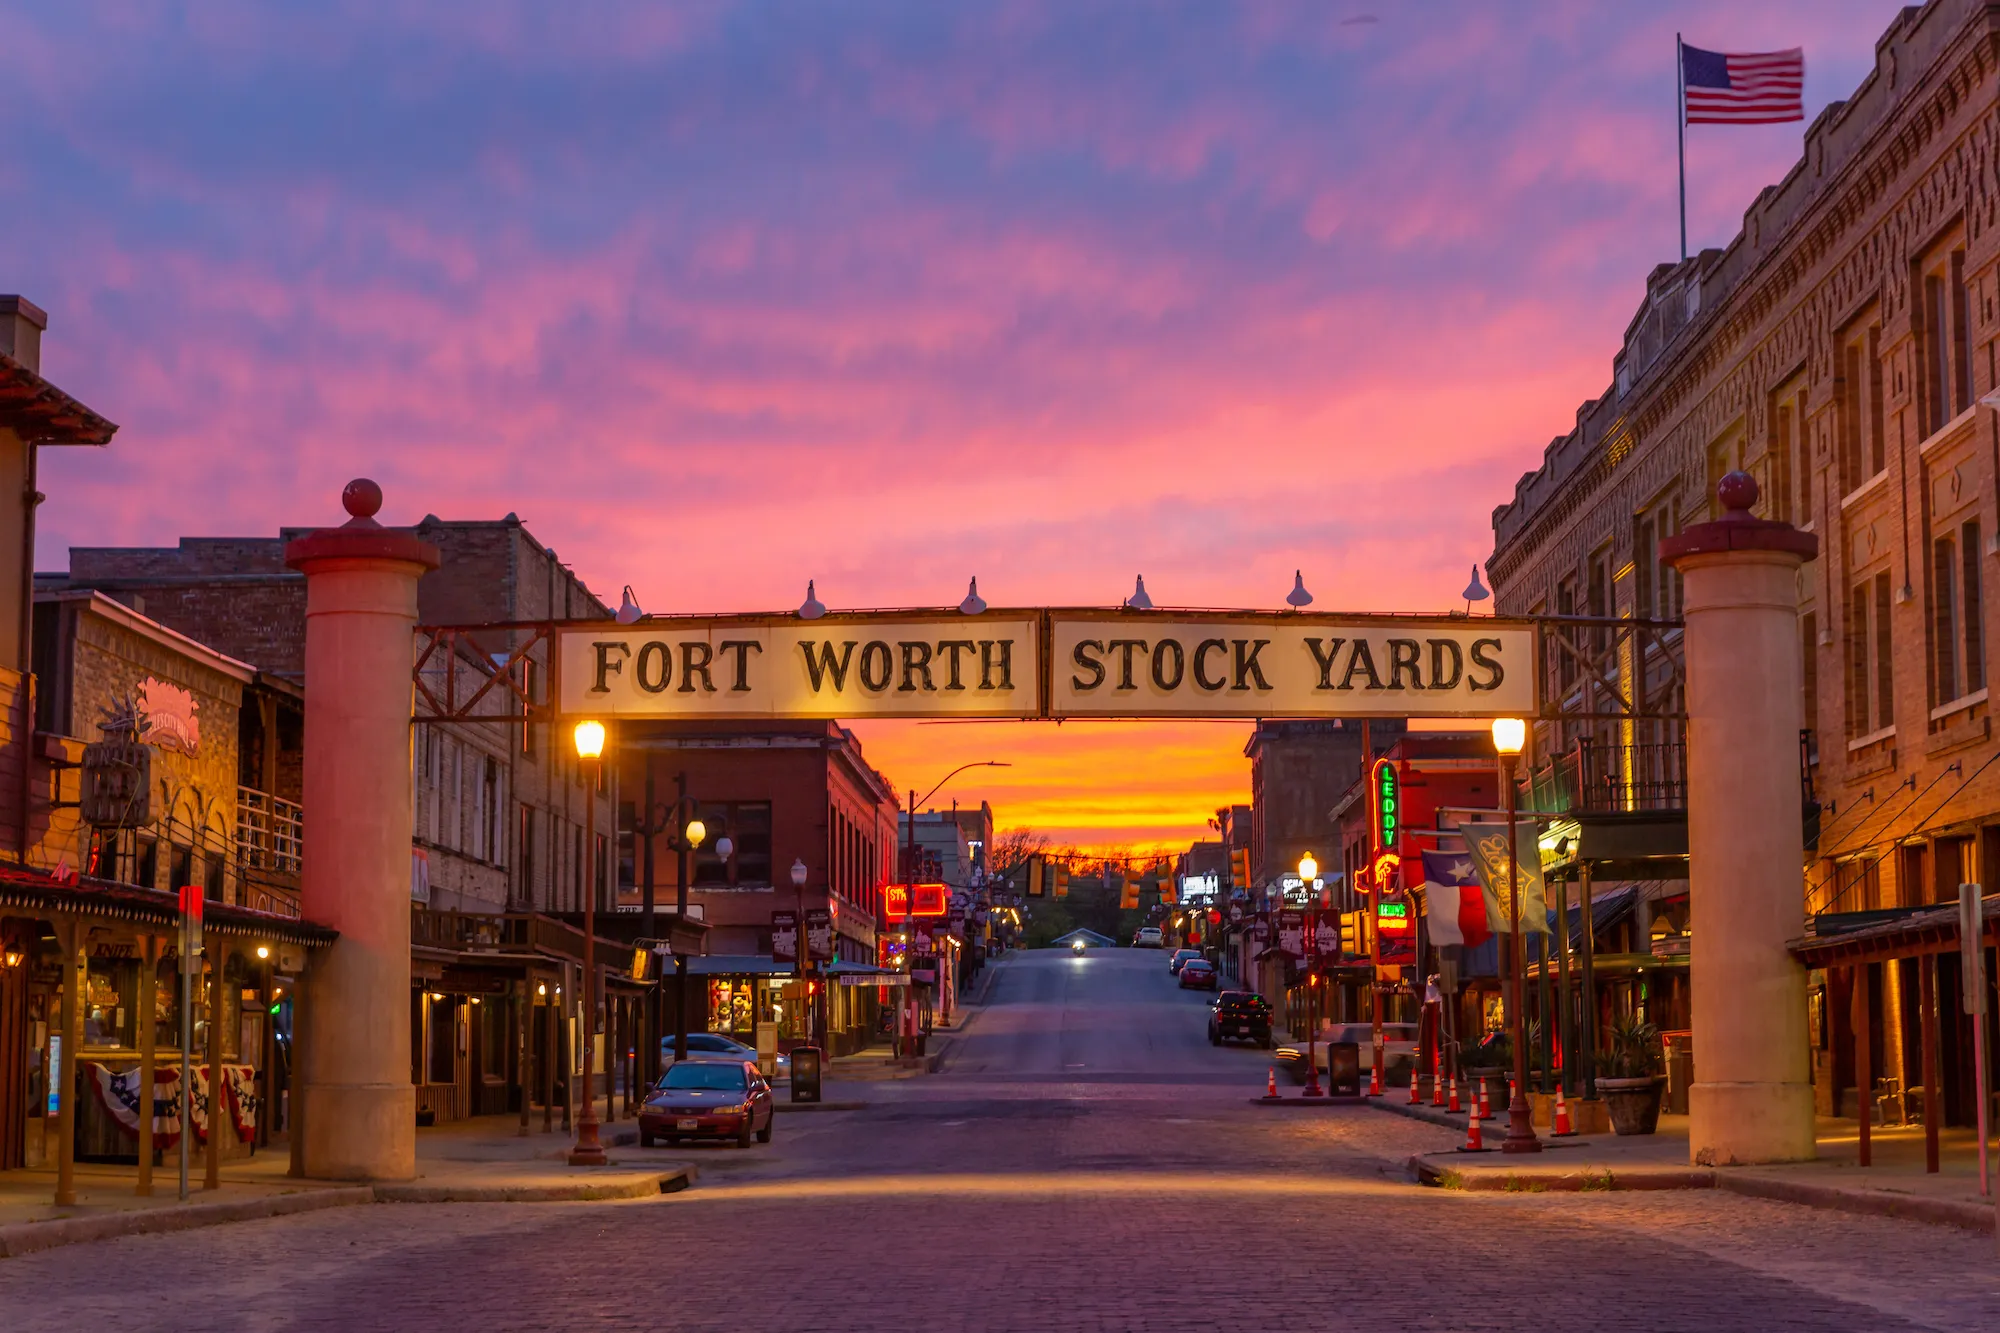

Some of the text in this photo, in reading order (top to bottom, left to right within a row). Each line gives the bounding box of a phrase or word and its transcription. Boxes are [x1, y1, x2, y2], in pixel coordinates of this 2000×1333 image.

[591, 638, 1505, 693] FORT WORTH STOCK YARDS
[1382, 767, 1396, 846] LEDDY
[93, 943, 135, 958] KNIFE
[842, 976, 854, 984] THE
